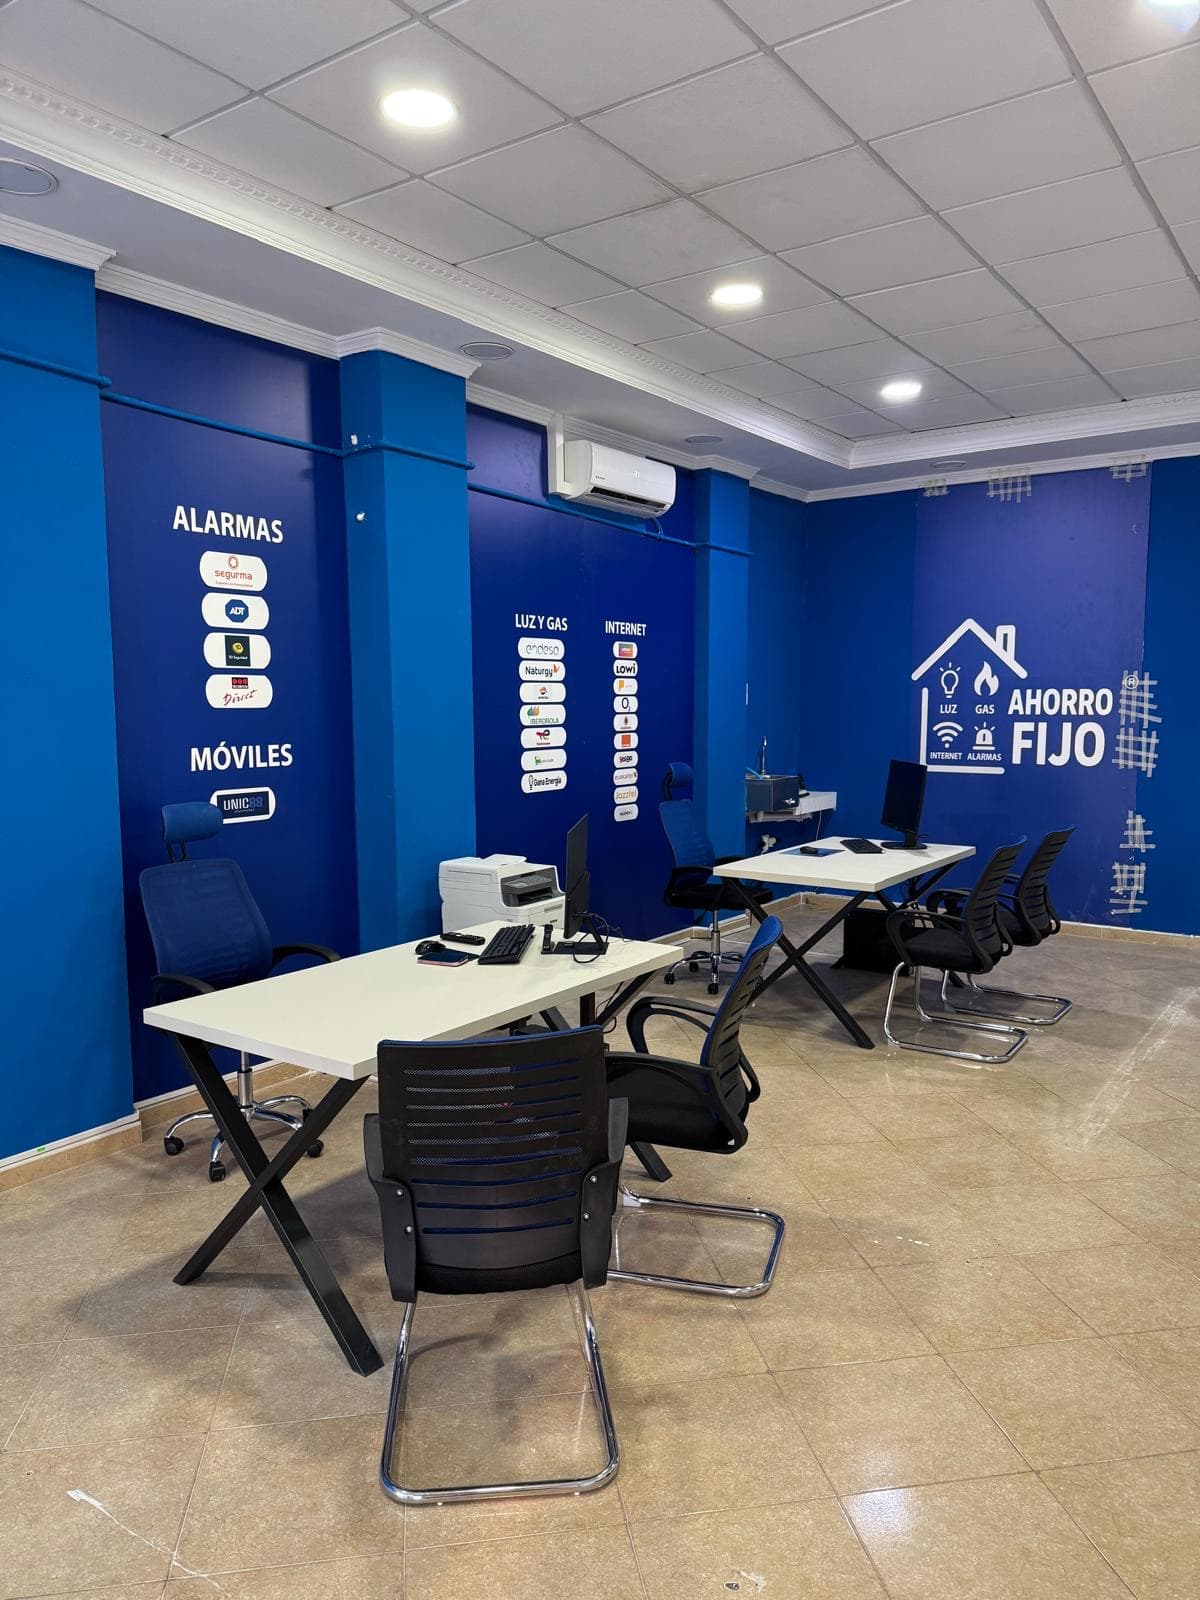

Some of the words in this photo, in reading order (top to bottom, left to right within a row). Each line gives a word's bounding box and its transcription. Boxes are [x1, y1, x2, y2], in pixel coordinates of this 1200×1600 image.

[172, 505, 284, 544] ALARMAS
[214, 570, 253, 580] segurma
[229, 607, 245, 616] ADT
[515, 613, 536, 629] LUZ
[537, 615, 545, 629] Y
[546, 616, 568, 631] GAS
[605, 620, 647, 636] INTERNET
[525, 643, 560, 656] endesa
[525, 666, 553, 677] Naturgy
[939, 704, 958, 714] LUZ
[975, 704, 995, 714] GAS
[1007, 688, 1114, 716] AHORRO
[1011, 721, 1106, 767] FIJO
[190, 741, 293, 772] MÓVILES
[929, 751, 963, 761] INTERNET
[966, 752, 1002, 761] ALARMAS
